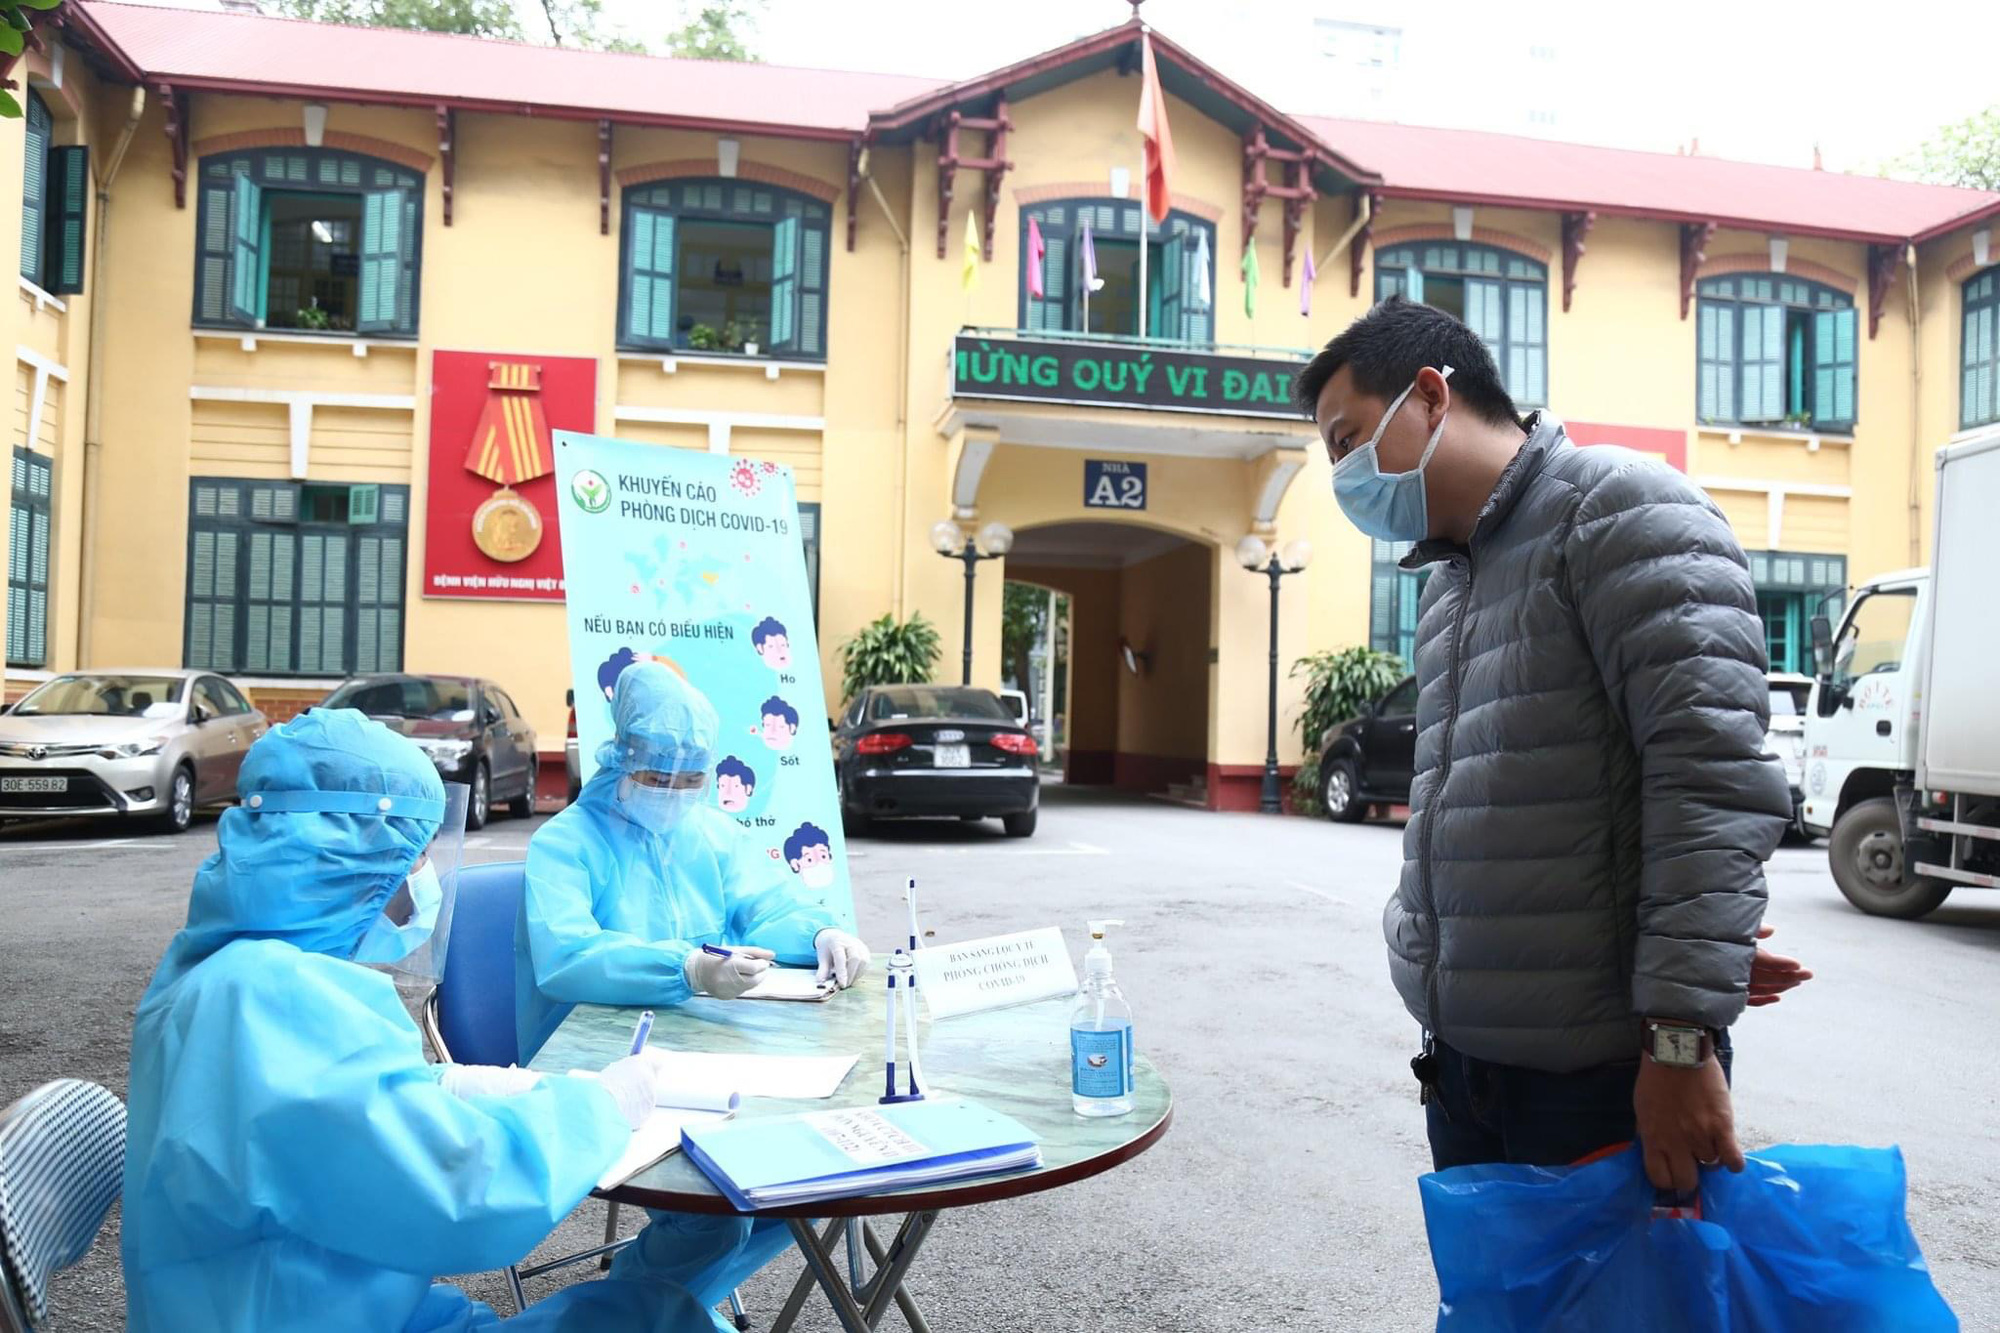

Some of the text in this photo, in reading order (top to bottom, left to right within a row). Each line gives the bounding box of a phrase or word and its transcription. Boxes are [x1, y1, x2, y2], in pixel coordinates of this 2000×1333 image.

[618, 473, 682, 499] KHUYẾN
[1089, 476, 1143, 507] A2
[621, 498, 789, 536] PHÒNG DỊCH COVID-19
[616, 619, 645, 640] BẠN
[648, 618, 667, 637] CÓ
[780, 674, 796, 684] Ho
